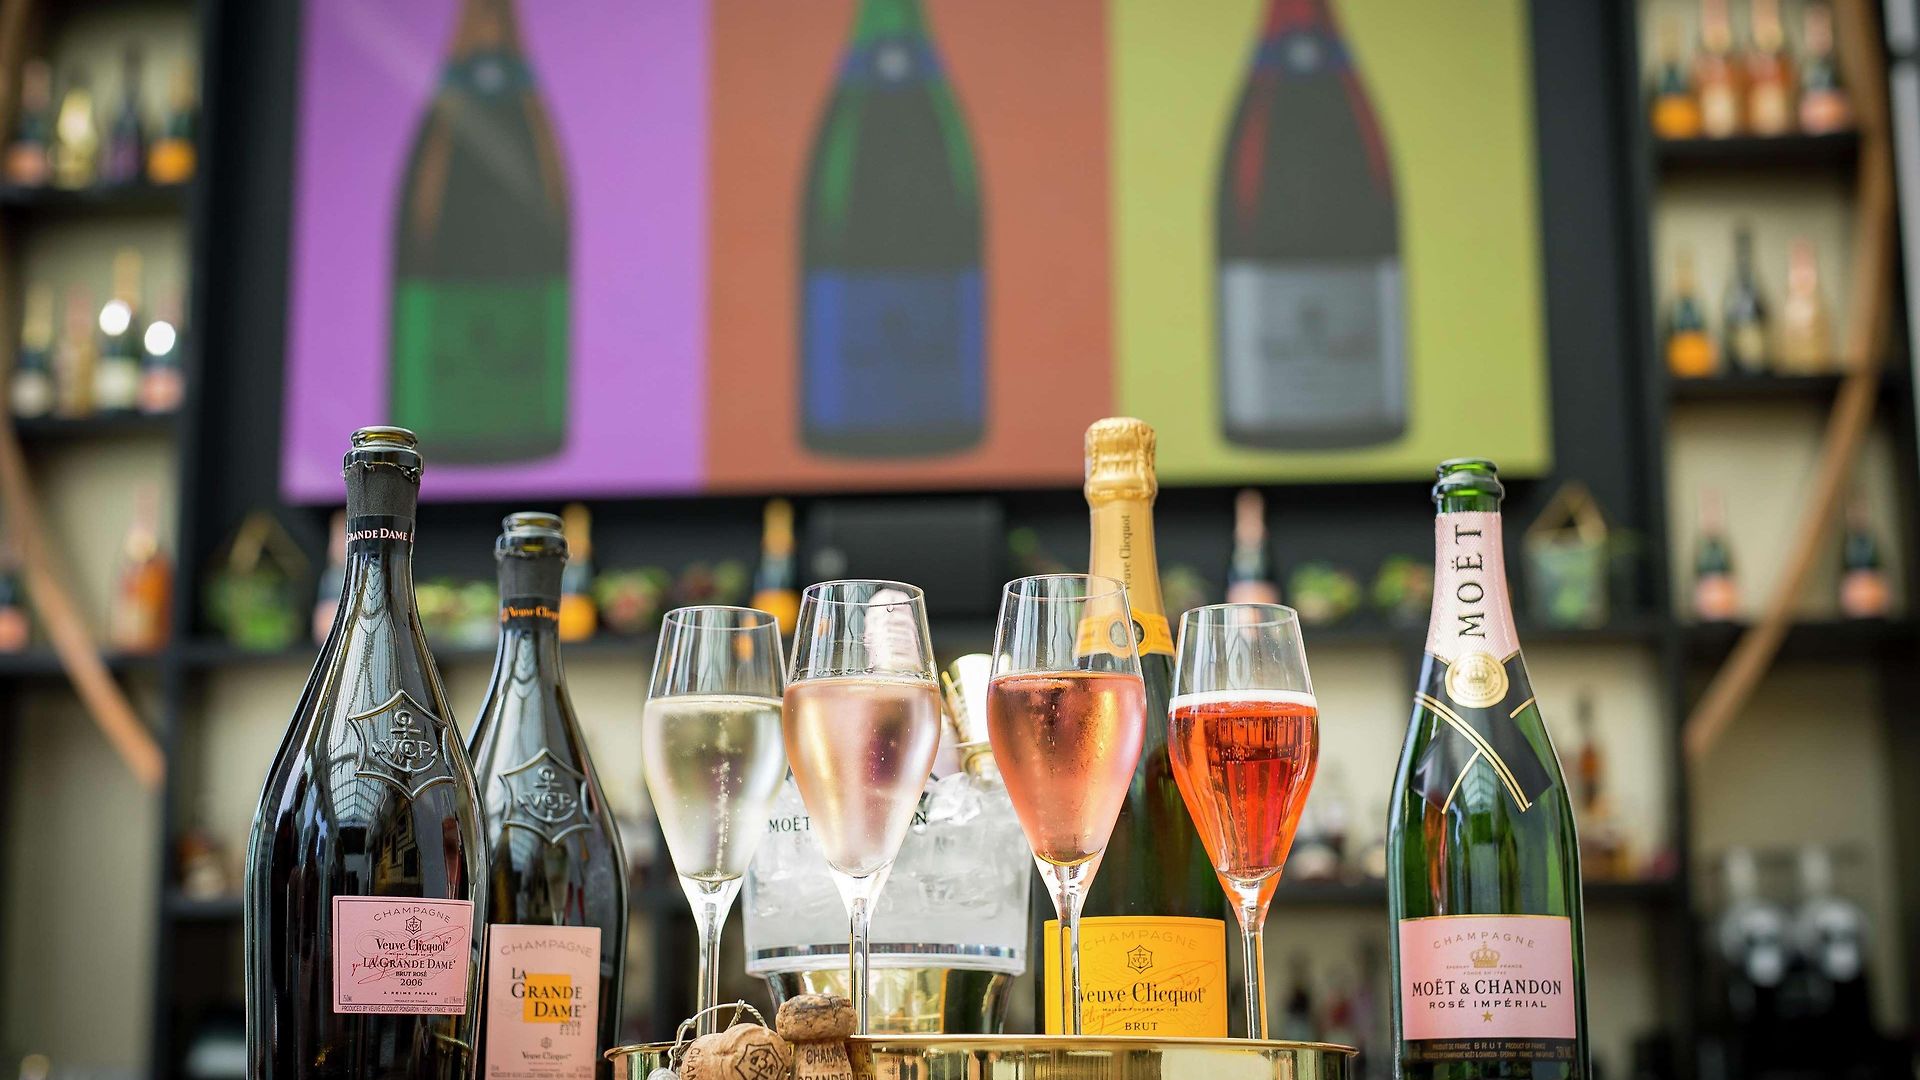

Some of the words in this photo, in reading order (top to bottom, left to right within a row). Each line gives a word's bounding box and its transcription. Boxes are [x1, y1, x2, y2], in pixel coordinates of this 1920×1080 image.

[380, 528, 407, 541] DAME
[1452, 524, 1485, 639] MOËT
[768, 815, 810, 833] MOËT
[373, 906, 451, 924] CHAMPAGNE
[375, 938, 405, 950] Veuve
[500, 939, 593, 958] CHAMPAGNE
[1083, 929, 1199, 951] CHAMPAGNE
[1433, 931, 1535, 949] CHAMPAGNE
[363, 957, 377, 968] LA
[379, 957, 424, 969] GRANDE
[427, 958, 452, 970] DAME
[511, 967, 528, 980] LA
[400, 978, 423, 987] 2006
[511, 982, 583, 1000] GRANDE
[1412, 979, 1456, 997] MOËT
[1459, 983, 1471, 995] &
[1474, 979, 1562, 996] CHANDON
[1132, 982, 1204, 1007] Clicquot
[534, 1001, 582, 1018] DAME
[1429, 999, 1465, 1009] ROSÉ
[1474, 998, 1547, 1008] IMPÉRIAL
[1125, 1022, 1158, 1031] BRUT
[1474, 1042, 1502, 1050] BRUT
